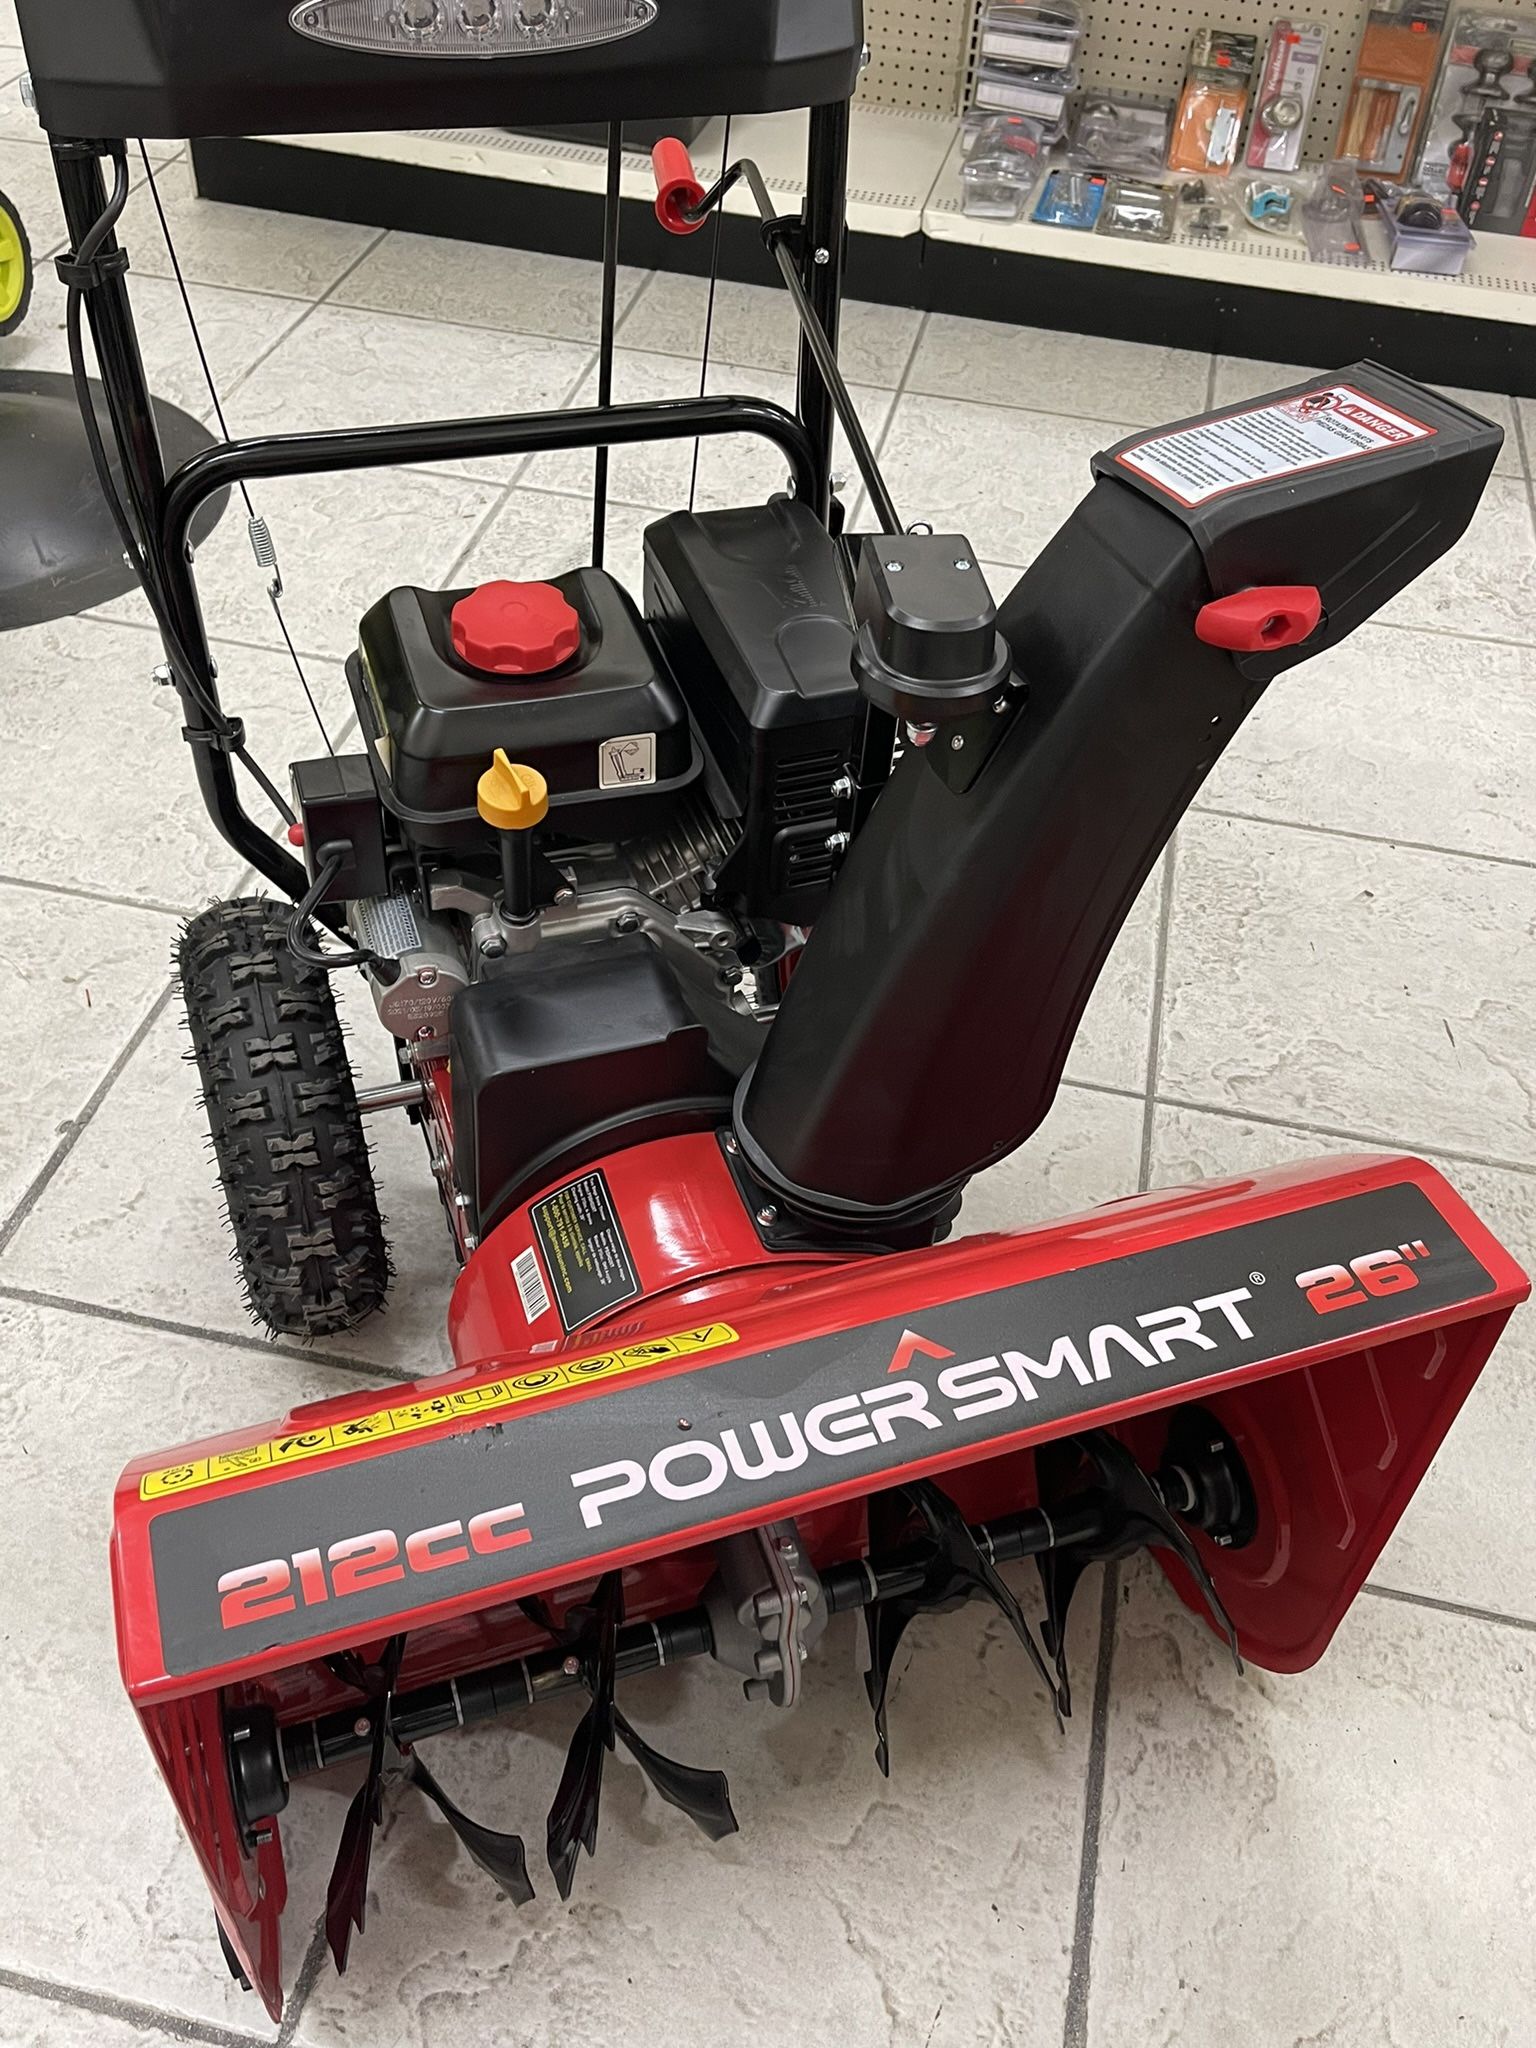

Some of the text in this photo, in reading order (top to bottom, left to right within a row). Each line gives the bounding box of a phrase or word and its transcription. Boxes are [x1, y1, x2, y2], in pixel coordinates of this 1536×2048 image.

[1351, 431, 1375, 444] PARTS
[1352, 412, 1407, 440] DANGER
[1296, 1240, 1430, 1314] 26"
[217, 1502, 532, 1630] 212cc
